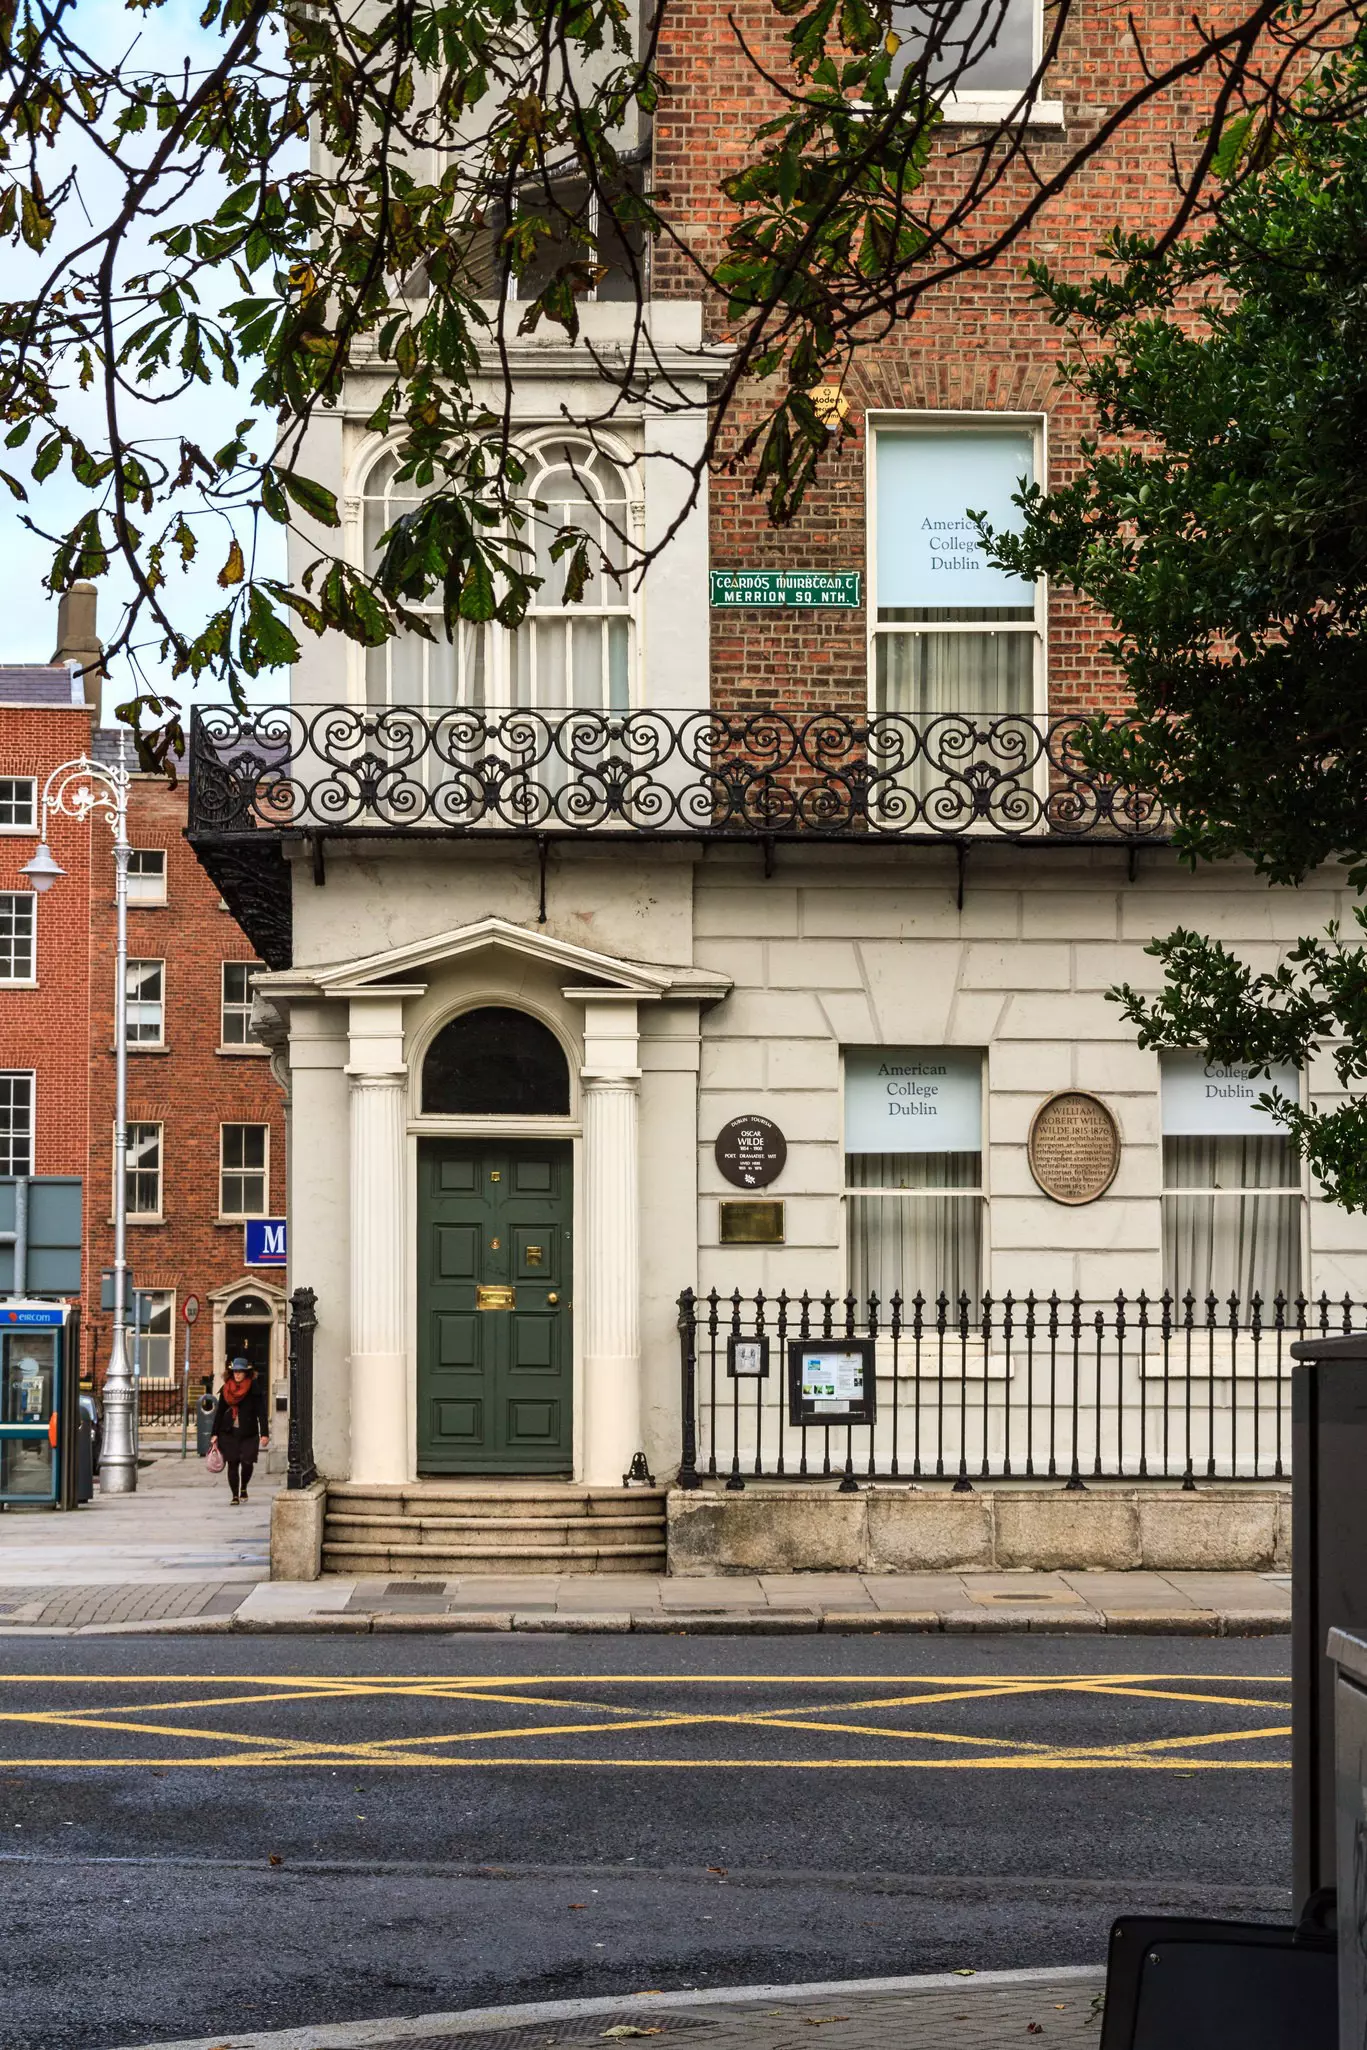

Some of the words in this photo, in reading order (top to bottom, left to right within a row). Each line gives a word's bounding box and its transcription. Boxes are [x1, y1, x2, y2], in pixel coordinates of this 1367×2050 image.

[921, 517, 989, 530] American
[931, 556, 980, 570] Dublin
[724, 591, 786, 602] MERRION
[795, 591, 816, 604] SQ.
[821, 592, 850, 603] NTH.
[878, 1063, 947, 1076] American
[1204, 1066, 1249, 1081] Colleg
[886, 1082, 939, 1098] College
[1205, 1085, 1255, 1098] Dublin
[888, 1102, 938, 1116] Dublin
[731, 1117, 748, 1127] DUBLIN
[751, 1117, 772, 1128] TOURISM
[1041, 1117, 1079, 1125] ROBERT
[1080, 1117, 1108, 1125] WILLS
[737, 1138, 764, 1146] WILDE
[18, 1313, 51, 1322] eircom
